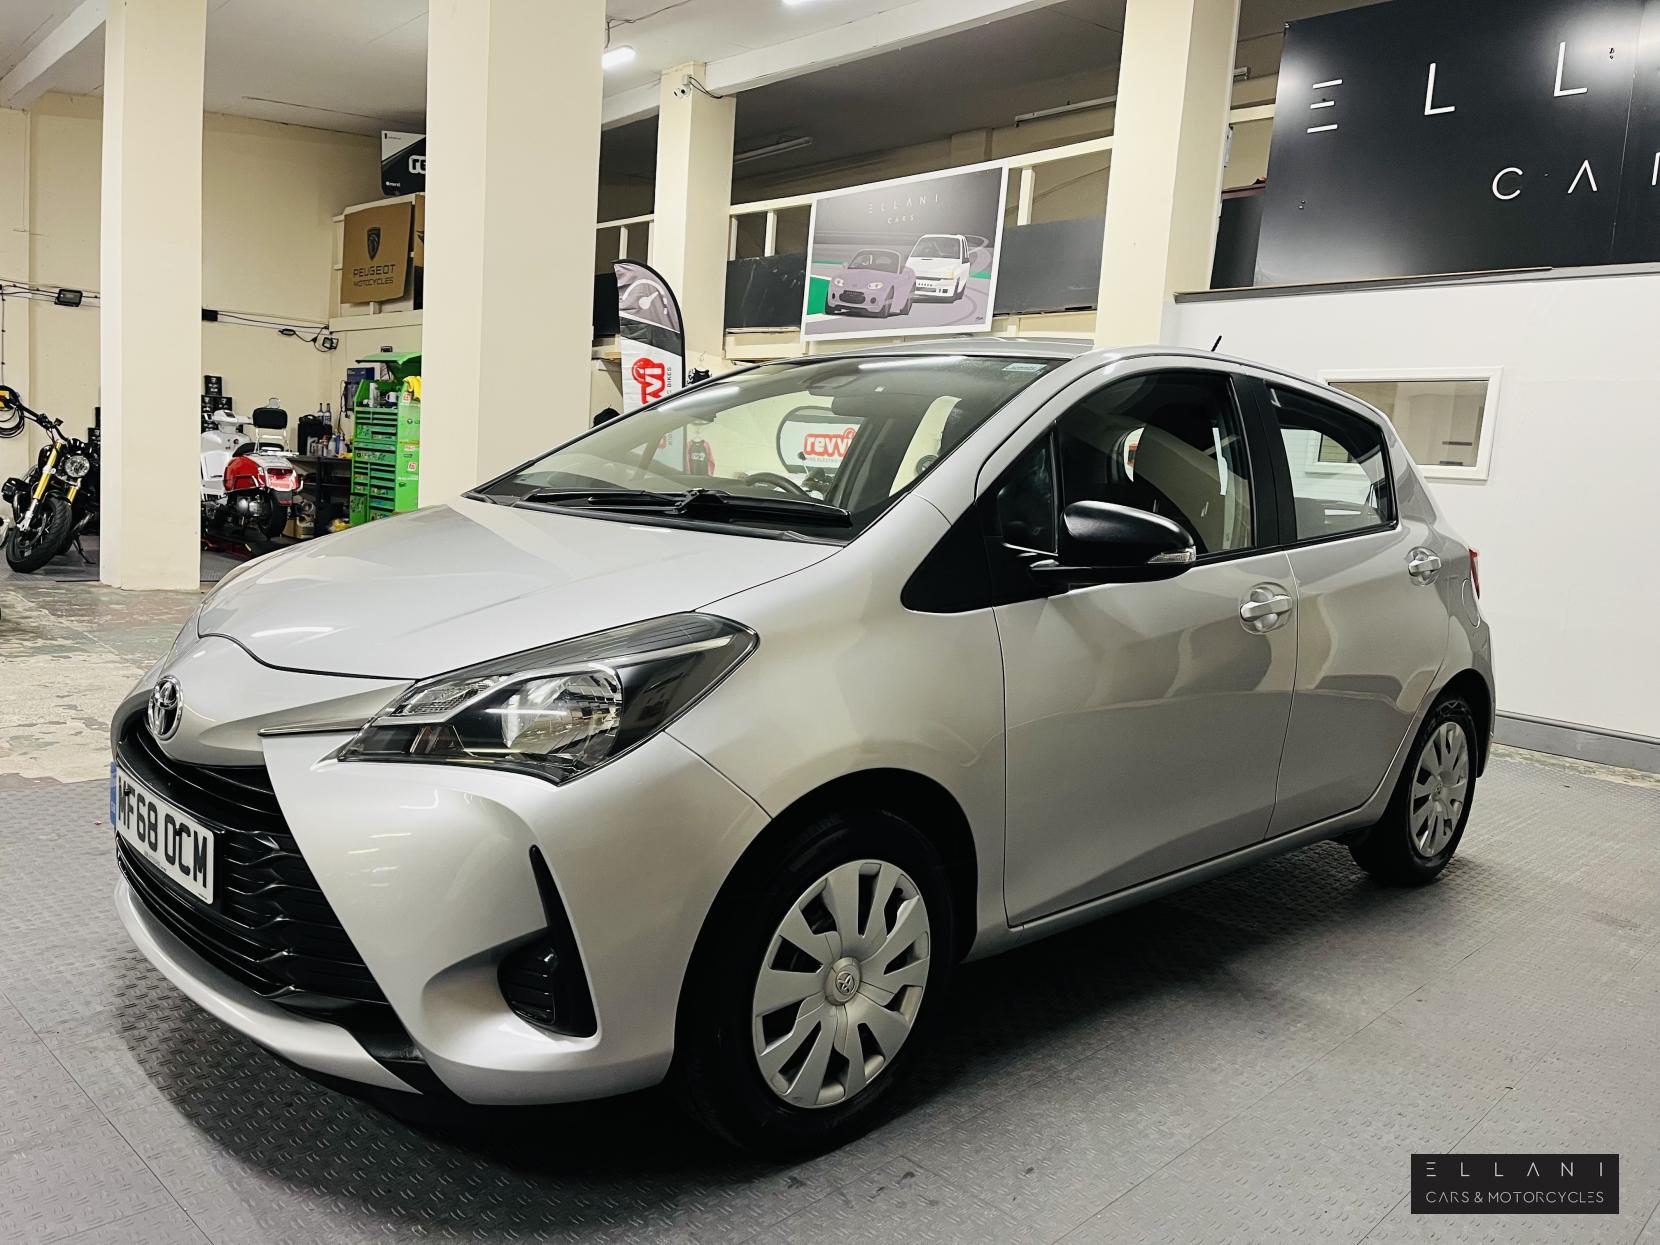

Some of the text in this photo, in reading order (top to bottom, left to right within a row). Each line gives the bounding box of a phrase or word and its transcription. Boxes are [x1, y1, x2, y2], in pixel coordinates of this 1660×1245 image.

[868, 193, 939, 214] ELLANI
[887, 214, 915, 225] CARS
[353, 264, 396, 277] PEUGEOT
[117, 775, 208, 889] MF68 OCM
